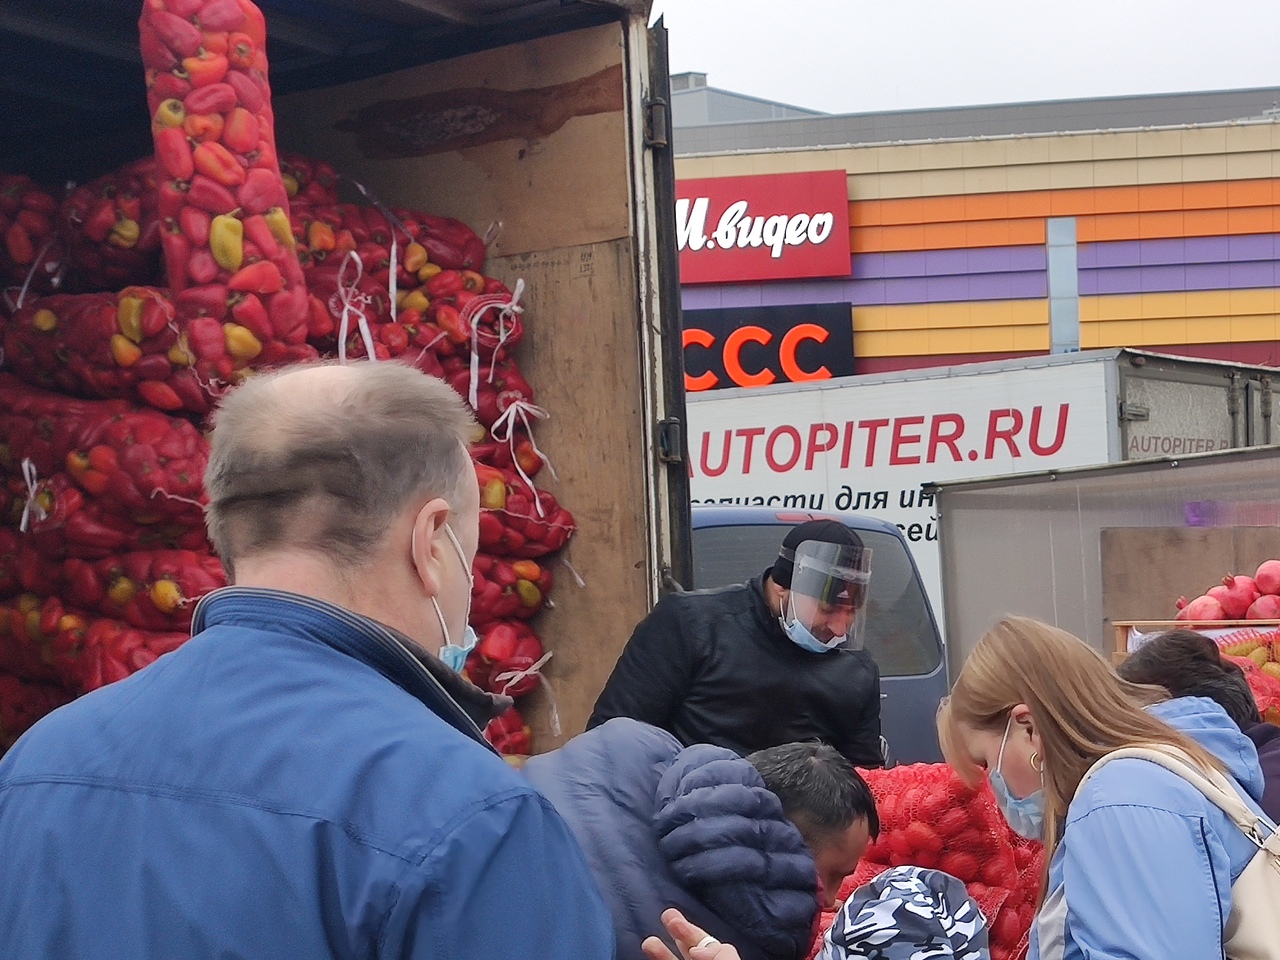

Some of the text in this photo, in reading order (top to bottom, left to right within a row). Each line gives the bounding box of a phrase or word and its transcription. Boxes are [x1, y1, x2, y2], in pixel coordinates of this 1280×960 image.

[682, 323, 833, 392] CCC
[686, 403, 1070, 478] UTOPITER.RU
[835, 485, 888, 510] для
